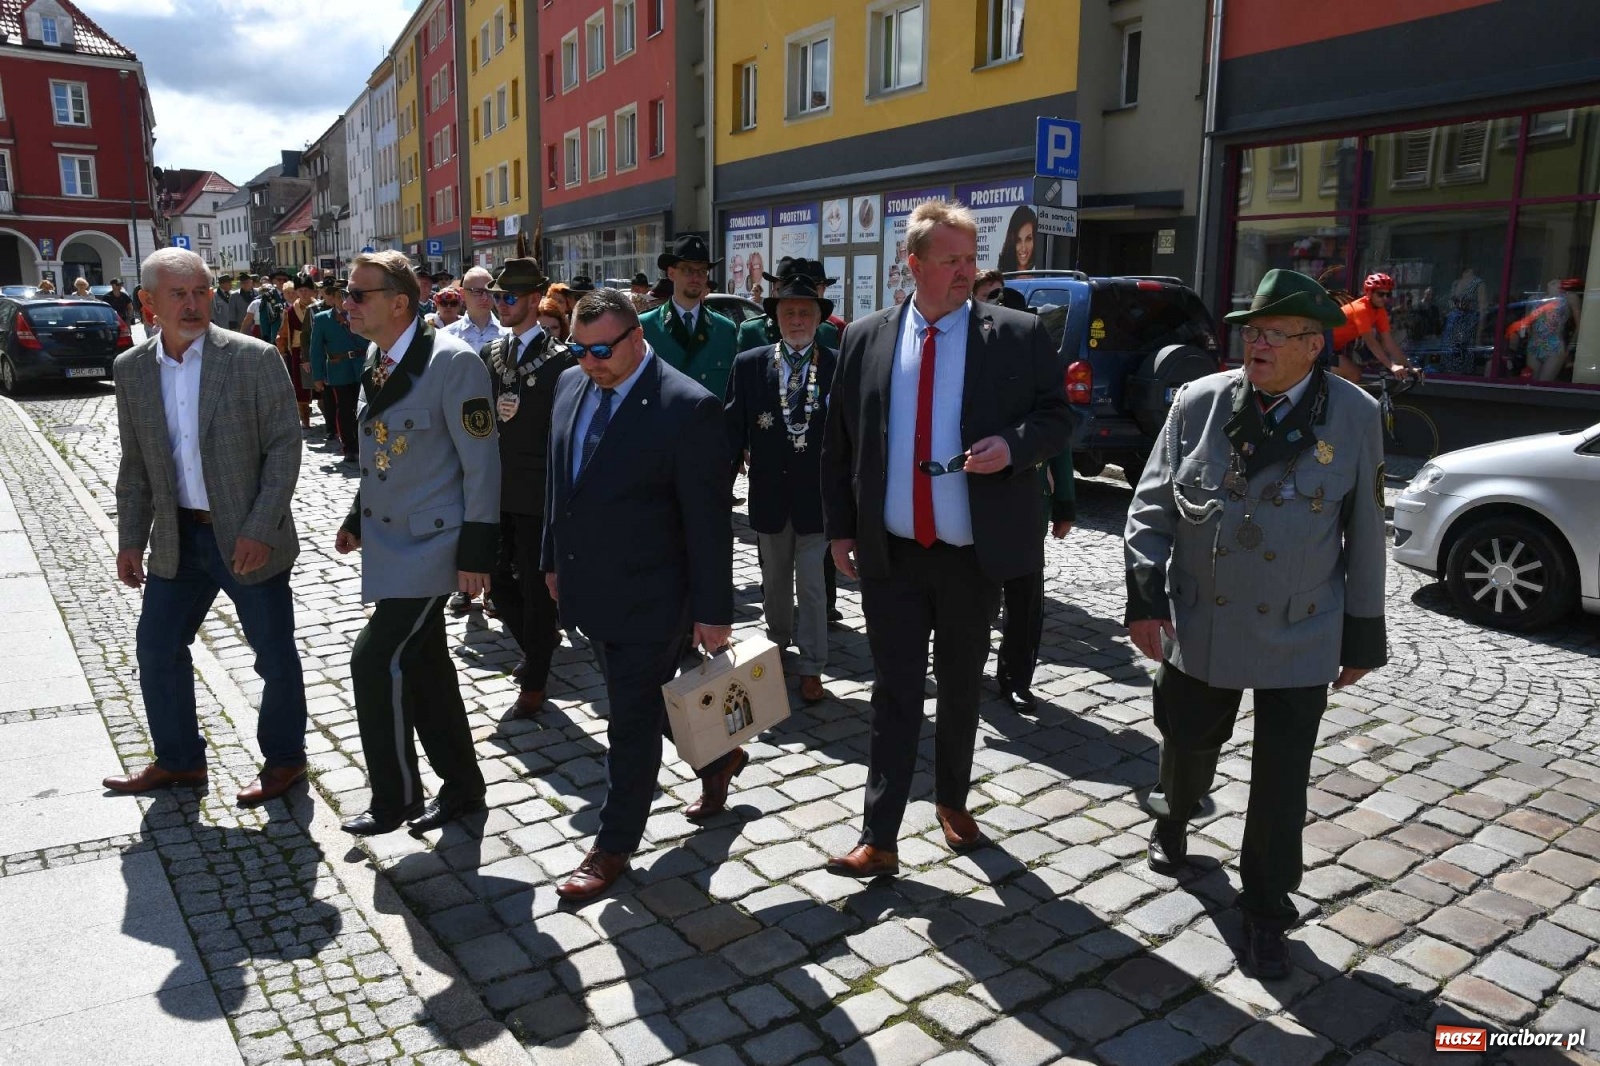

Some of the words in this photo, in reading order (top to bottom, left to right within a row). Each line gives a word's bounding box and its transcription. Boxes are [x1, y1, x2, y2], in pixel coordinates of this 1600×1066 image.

[1047, 125, 1073, 169] P
[971, 186, 1025, 206] PROTETYKA
[729, 215, 766, 228] STOMATOLOGIA
[780, 209, 811, 223] PROTETYKA
[1039, 211, 1049, 219] dla
[430, 241, 440, 254] P
[1161, 236, 1172, 247] 52
